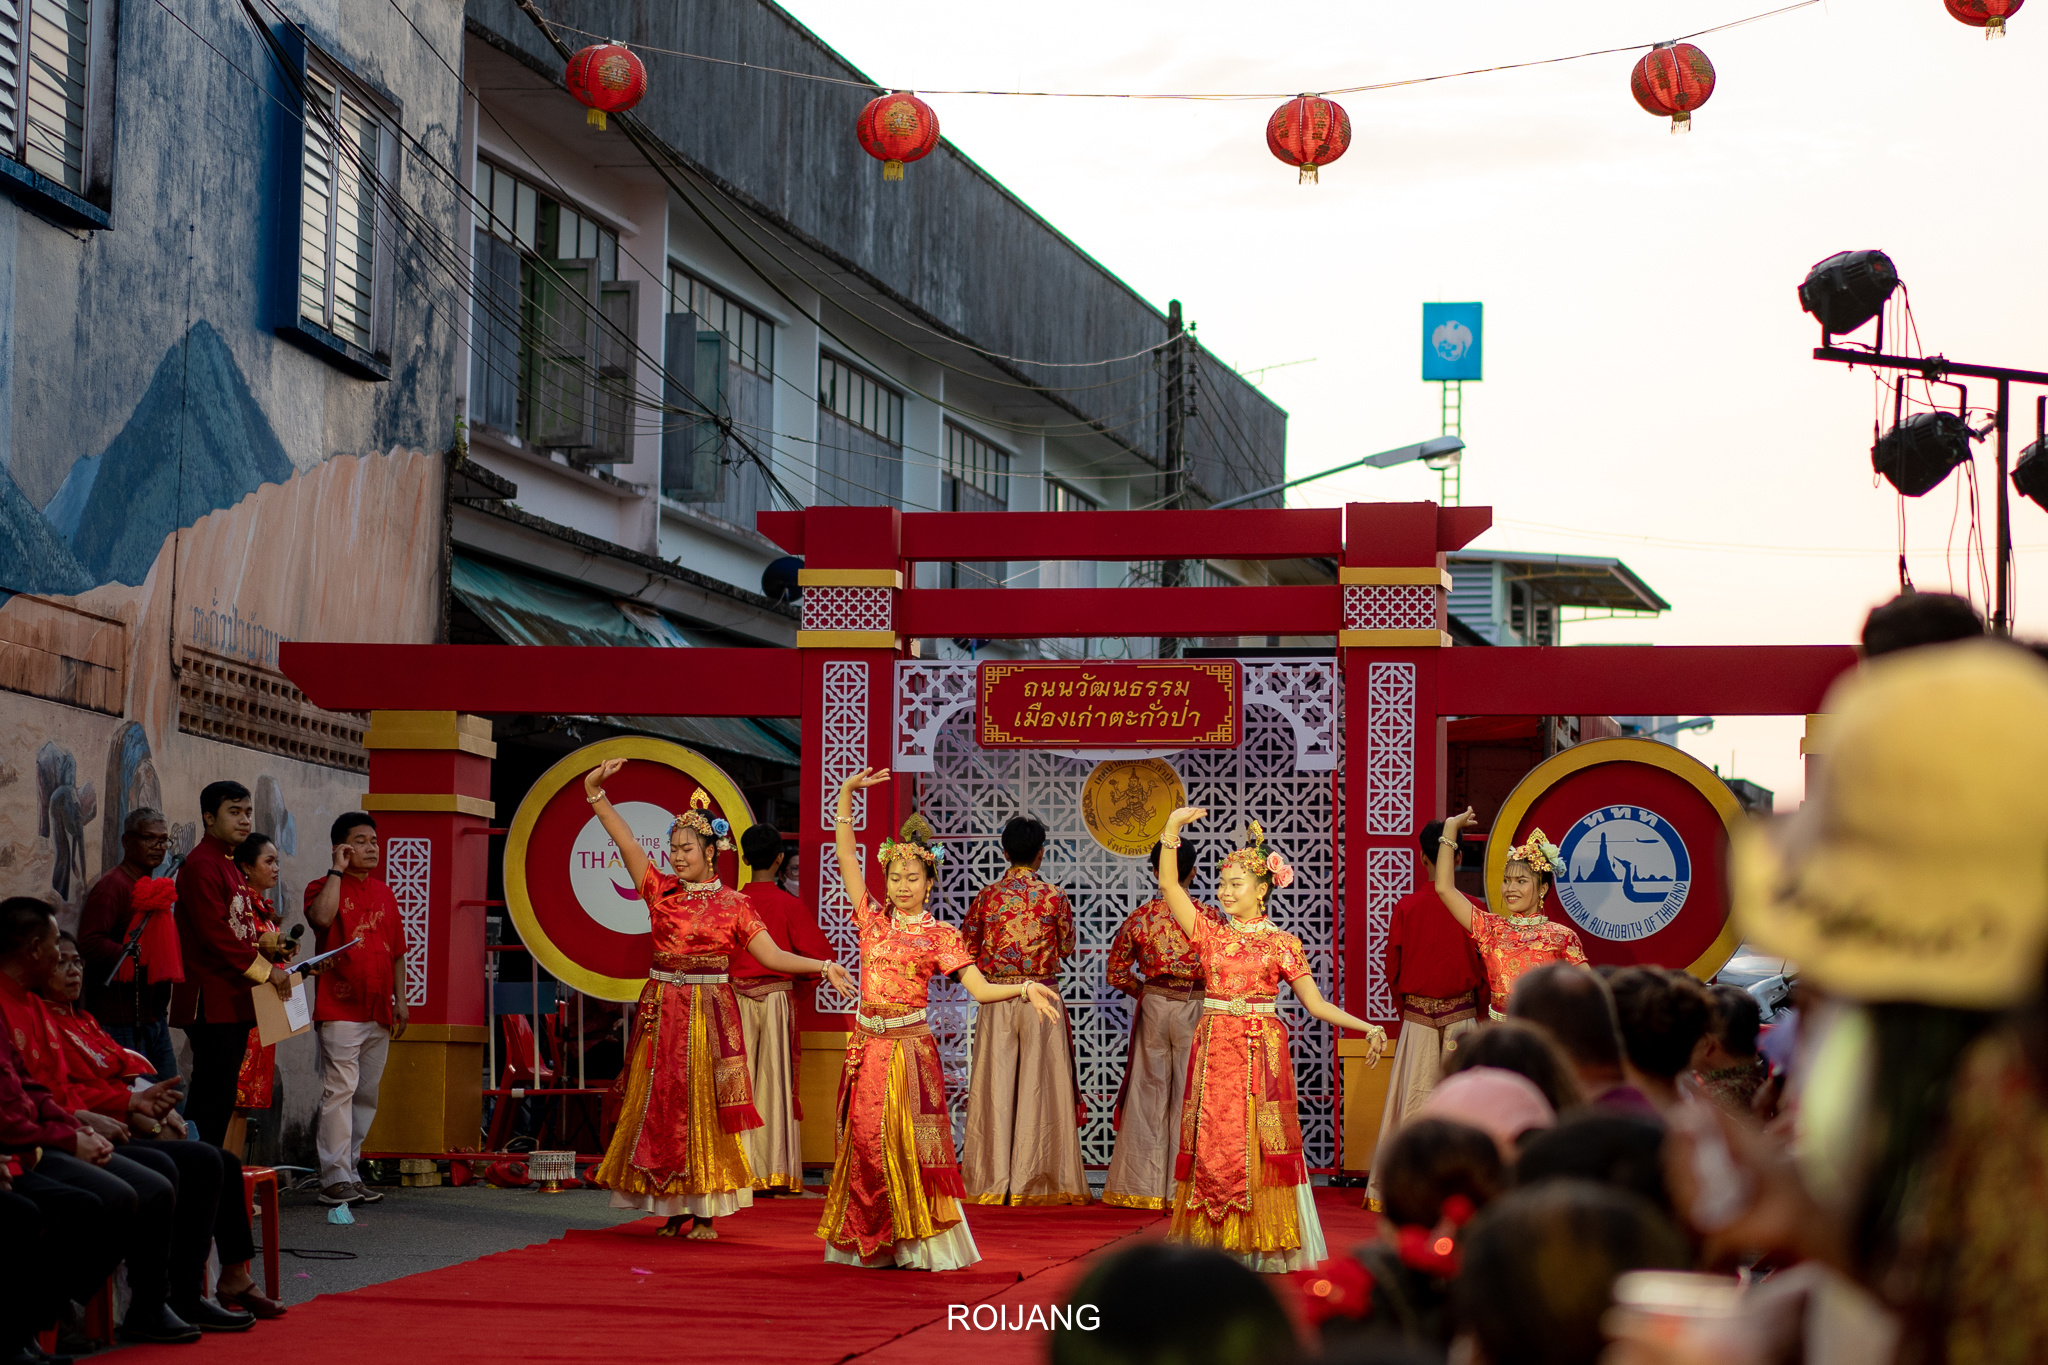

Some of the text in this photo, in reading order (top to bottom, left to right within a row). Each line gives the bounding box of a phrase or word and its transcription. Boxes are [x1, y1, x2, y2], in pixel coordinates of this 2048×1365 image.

[1024, 672, 1190, 698] ถนนวัฒนธรรม
[1014, 699, 1201, 728] เมืองเก่าตะกั่วป่า
[1583, 807, 1658, 828] ททท
[1559, 882, 1687, 939] TOURISM AUTHORITY OF THAILAND
